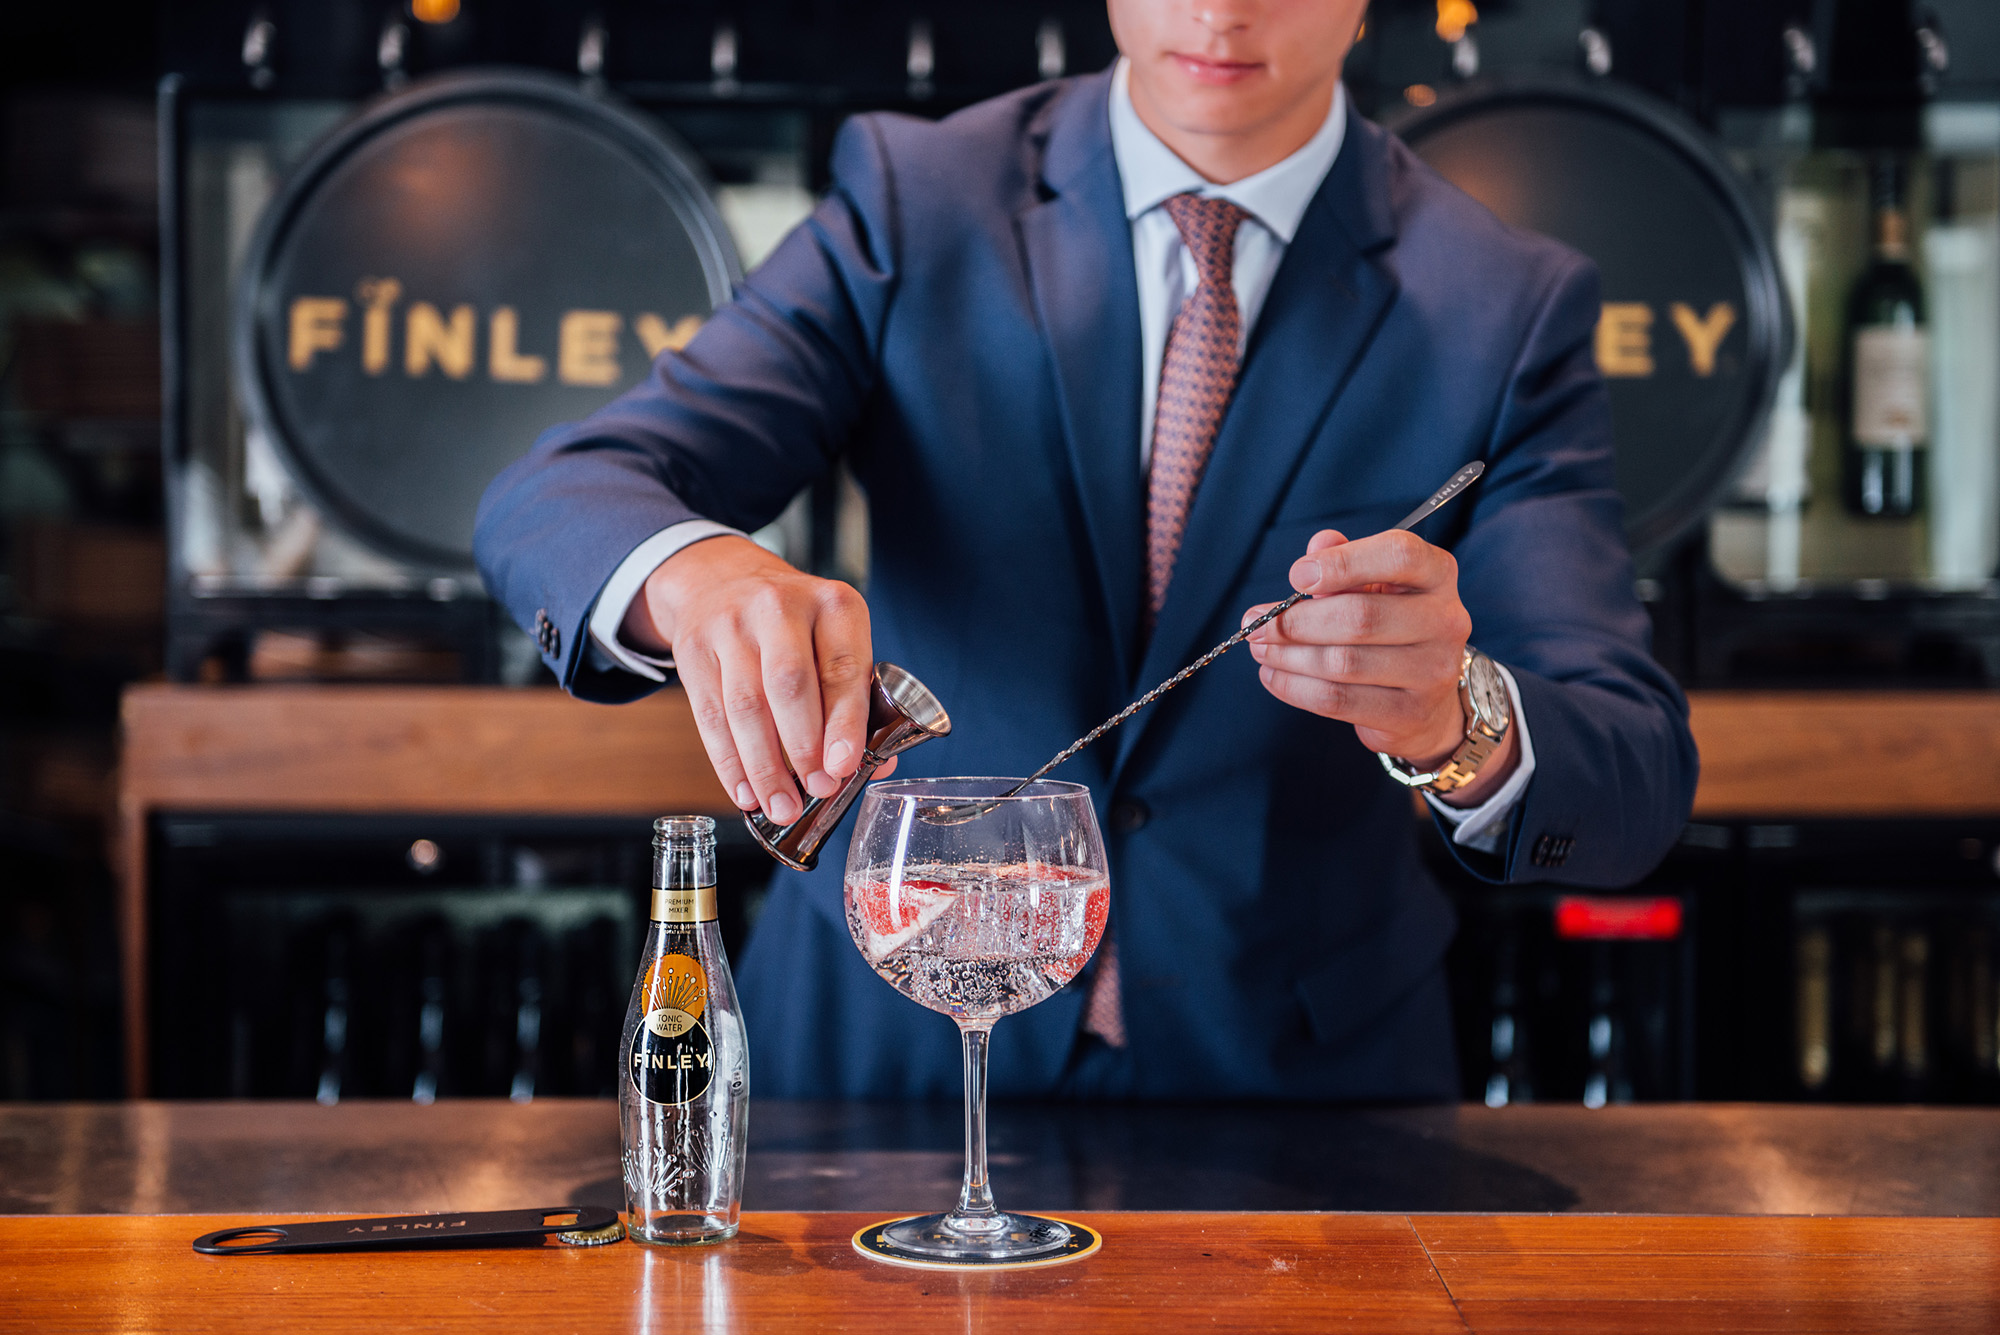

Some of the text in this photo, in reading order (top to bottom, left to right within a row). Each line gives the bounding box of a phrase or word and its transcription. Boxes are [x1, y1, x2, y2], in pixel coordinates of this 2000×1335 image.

[664, 898, 695, 906] PREMIUM
[668, 906, 689, 914] MIXER
[658, 1014, 683, 1023] TONIC
[656, 1023, 683, 1032] WATER
